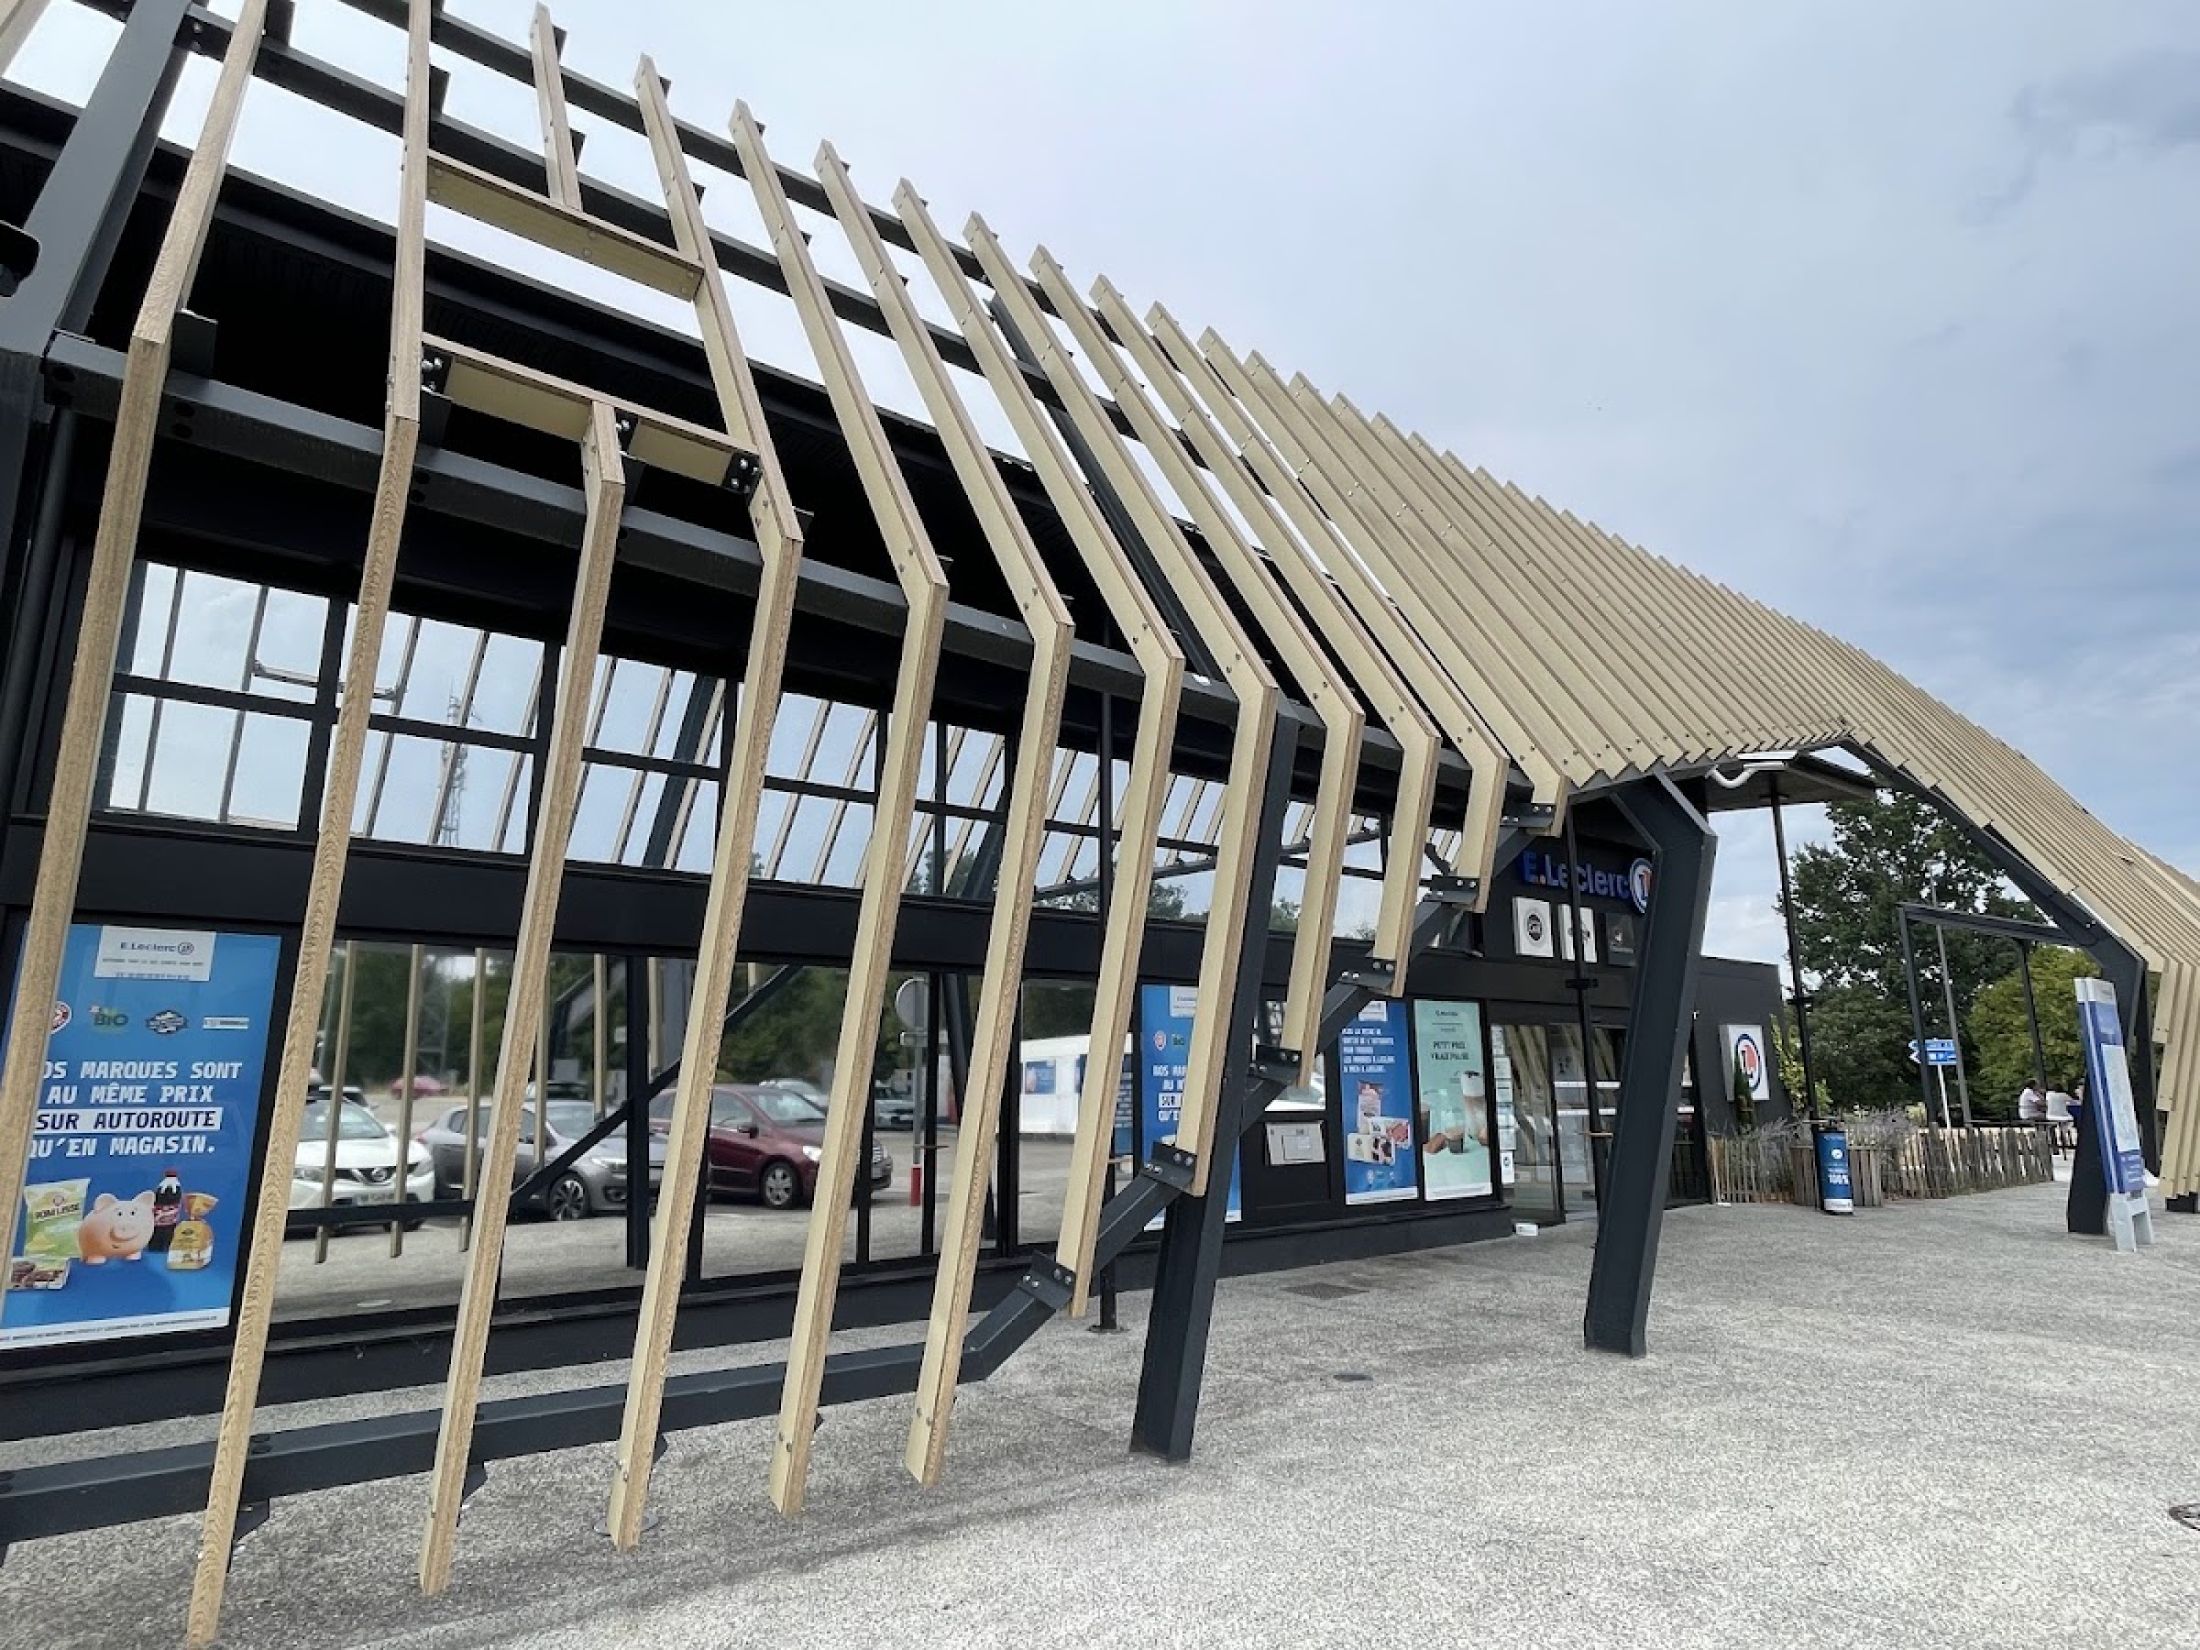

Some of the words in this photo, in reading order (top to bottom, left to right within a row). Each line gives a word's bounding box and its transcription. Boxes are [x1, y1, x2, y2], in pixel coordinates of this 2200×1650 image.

[42, 1061, 68, 1080] OS
[80, 1061, 179, 1080] MARQUES
[190, 1061, 243, 1080] SONT
[46, 1085, 77, 1104] AU
[89, 1081, 148, 1104] MÊME
[159, 1084, 214, 1103] PRIX
[36, 1113, 80, 1130] SUR
[93, 1110, 216, 1130] AUTOROUTE
[109, 1134, 216, 1156] MAGASIN.
